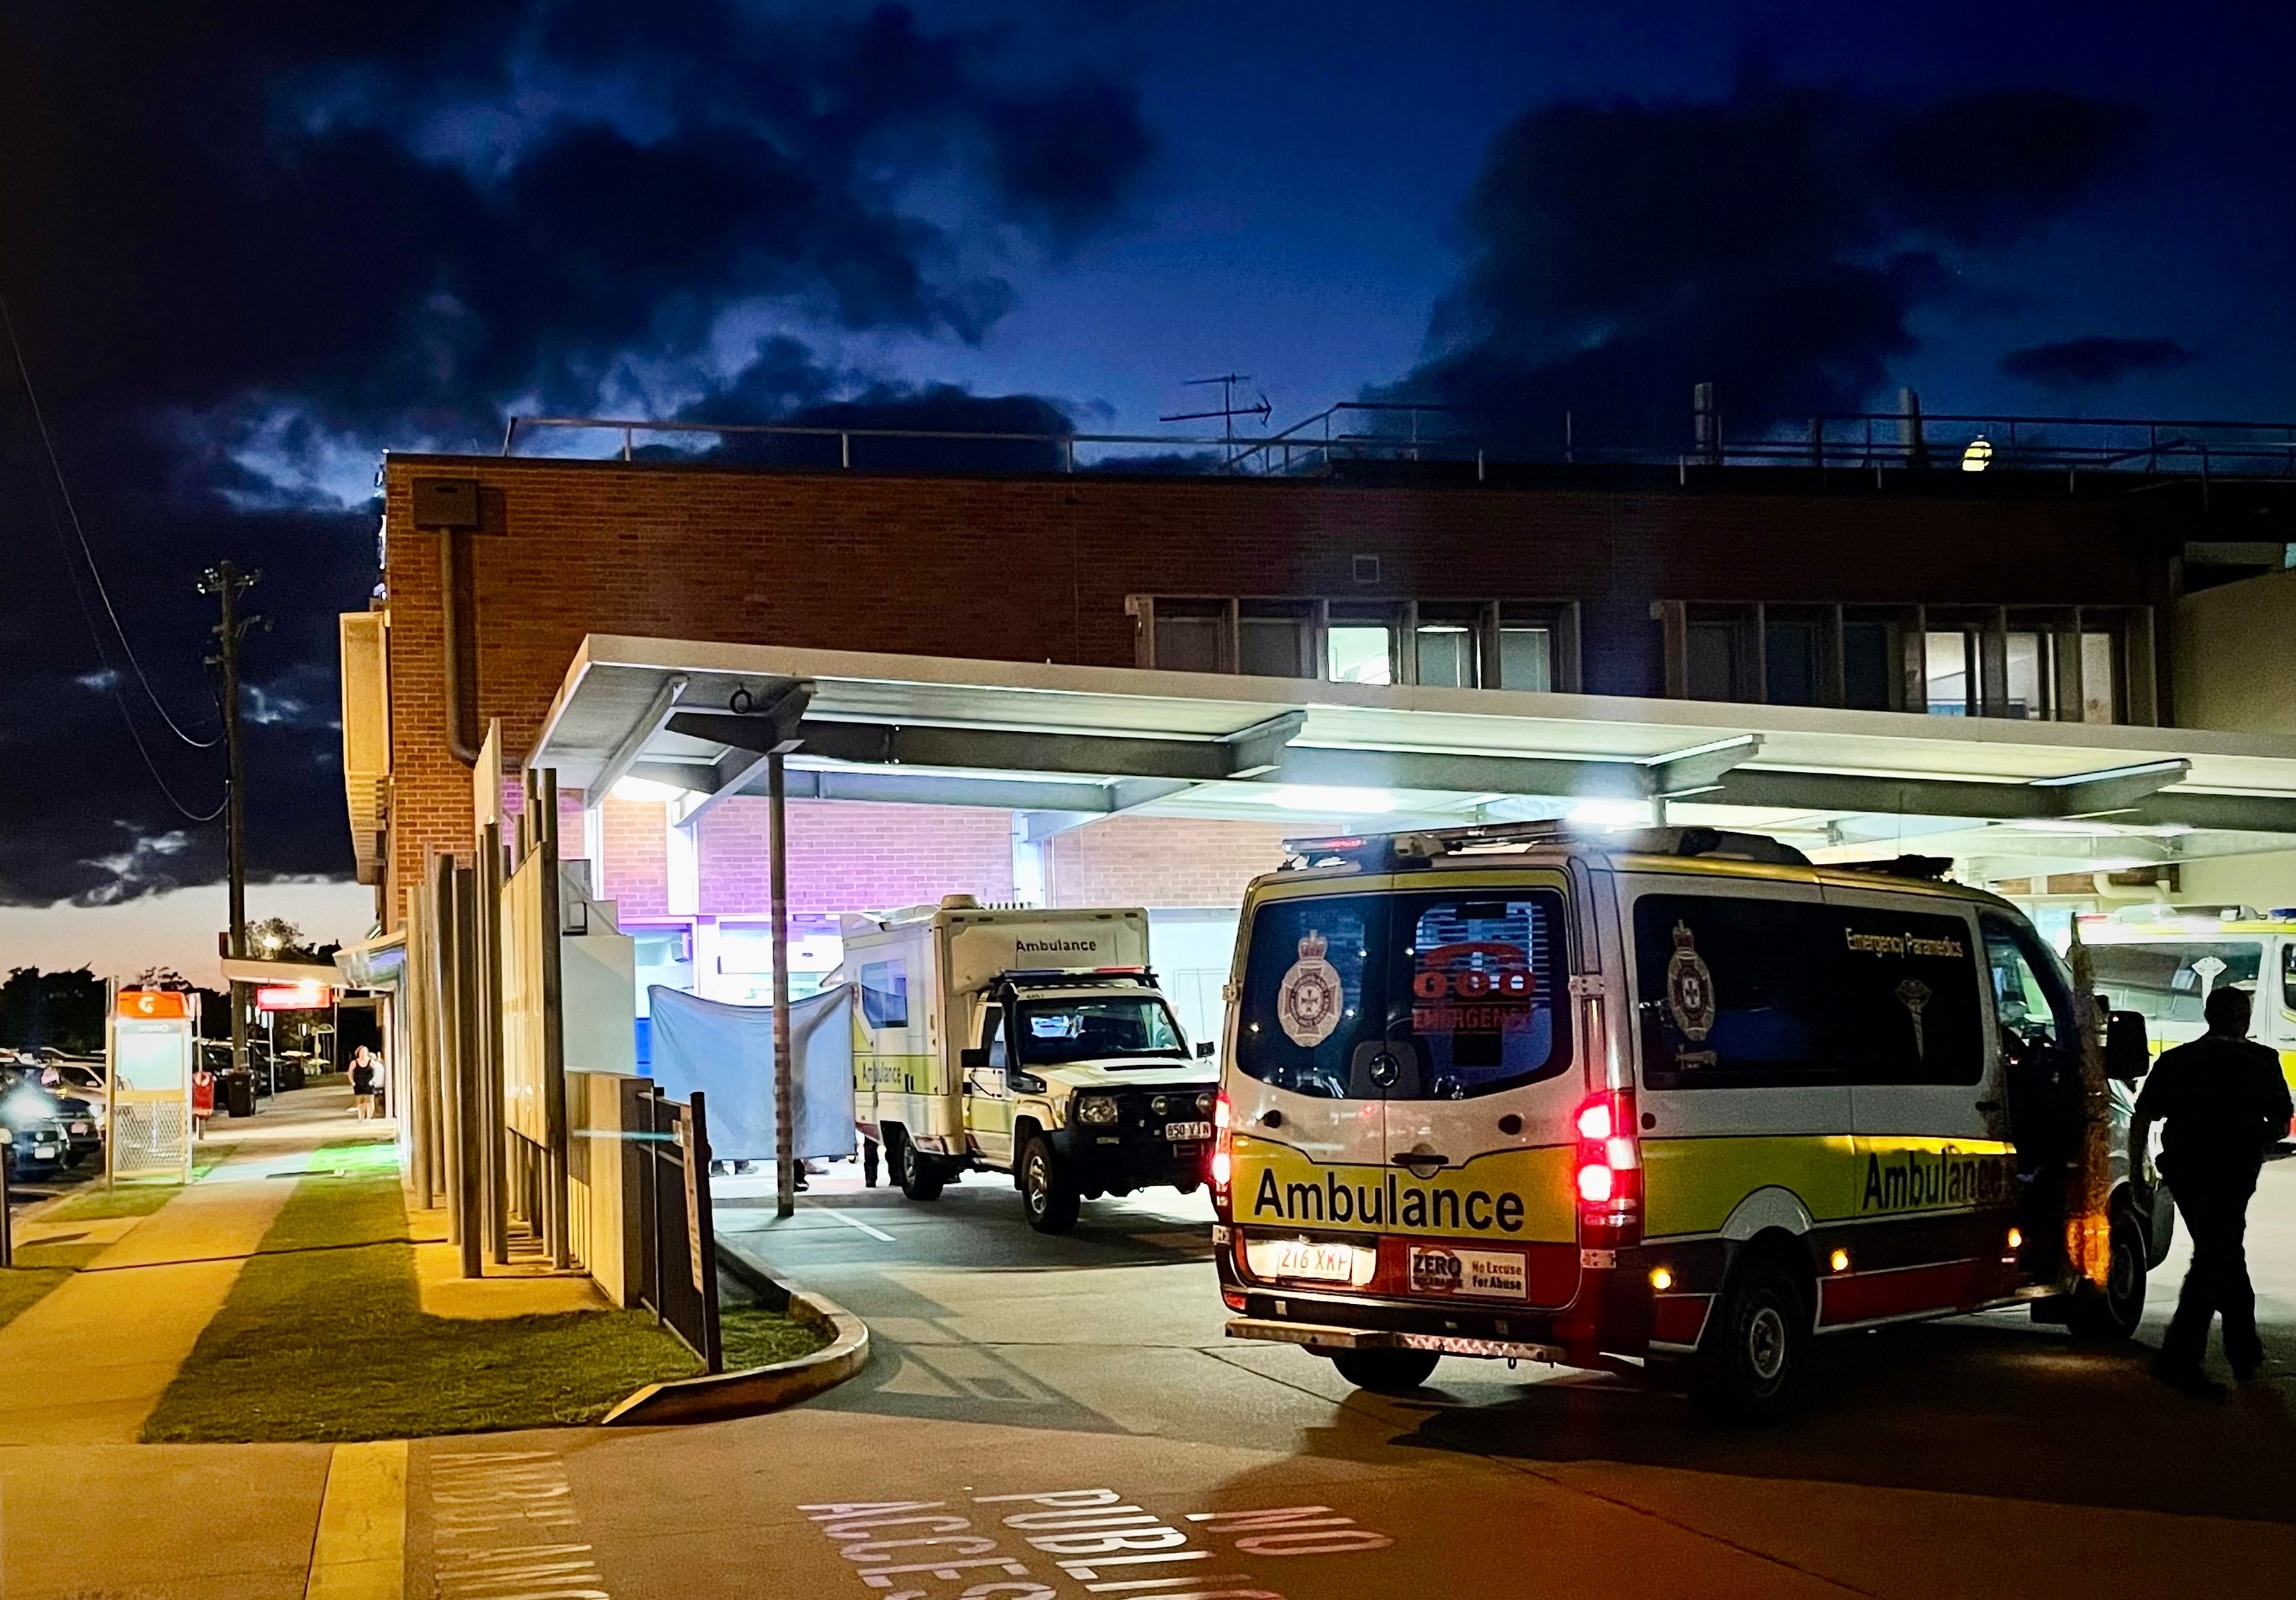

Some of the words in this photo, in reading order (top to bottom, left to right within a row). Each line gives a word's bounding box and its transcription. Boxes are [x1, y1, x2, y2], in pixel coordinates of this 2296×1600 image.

[1017, 940, 1097, 952] Ambulance
[1844, 928, 1904, 958] Emergency
[1905, 932, 1963, 958] Paramedics
[1413, 969, 1537, 998] 000
[1862, 1148, 2004, 1210] Ambulance
[1254, 1168, 1524, 1232] Ambulance
[1282, 1248, 1309, 1268] 216
[1413, 1254, 1462, 1278] ZERO
[1472, 1261, 1484, 1273] No
[1487, 1262, 1523, 1275] Excuse
[1472, 1275, 1488, 1288] For
[1490, 1276, 1522, 1291] Abuse
[1184, 1505, 1396, 1556] NO
[796, 1501, 1057, 1600] ACCES
